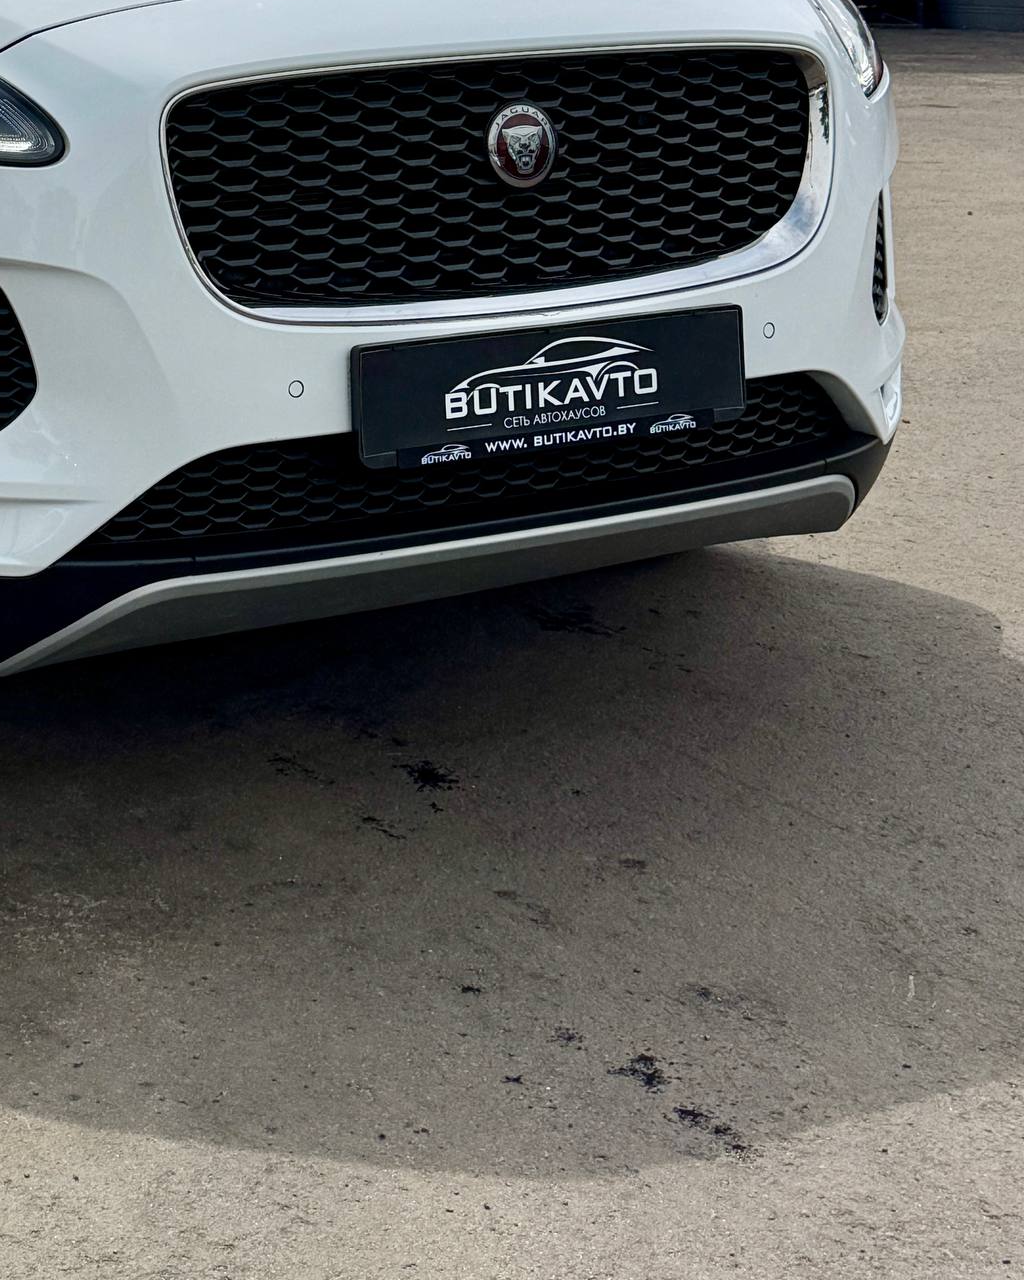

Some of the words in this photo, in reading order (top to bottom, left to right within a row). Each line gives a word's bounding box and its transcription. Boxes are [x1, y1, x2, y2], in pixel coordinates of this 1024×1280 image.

[495, 107, 548, 131] JAGUAR
[445, 368, 658, 419] BUTIKAVTO
[503, 416, 531, 429] СЕТЬ
[533, 405, 606, 425] АВТОХАУСОВ
[649, 421, 697, 434] BUTIKAVTO
[485, 437, 528, 453] WWW.
[533, 422, 636, 447] BUTIKAVTO.BY
[421, 451, 472, 465] BUTIKAVTO
